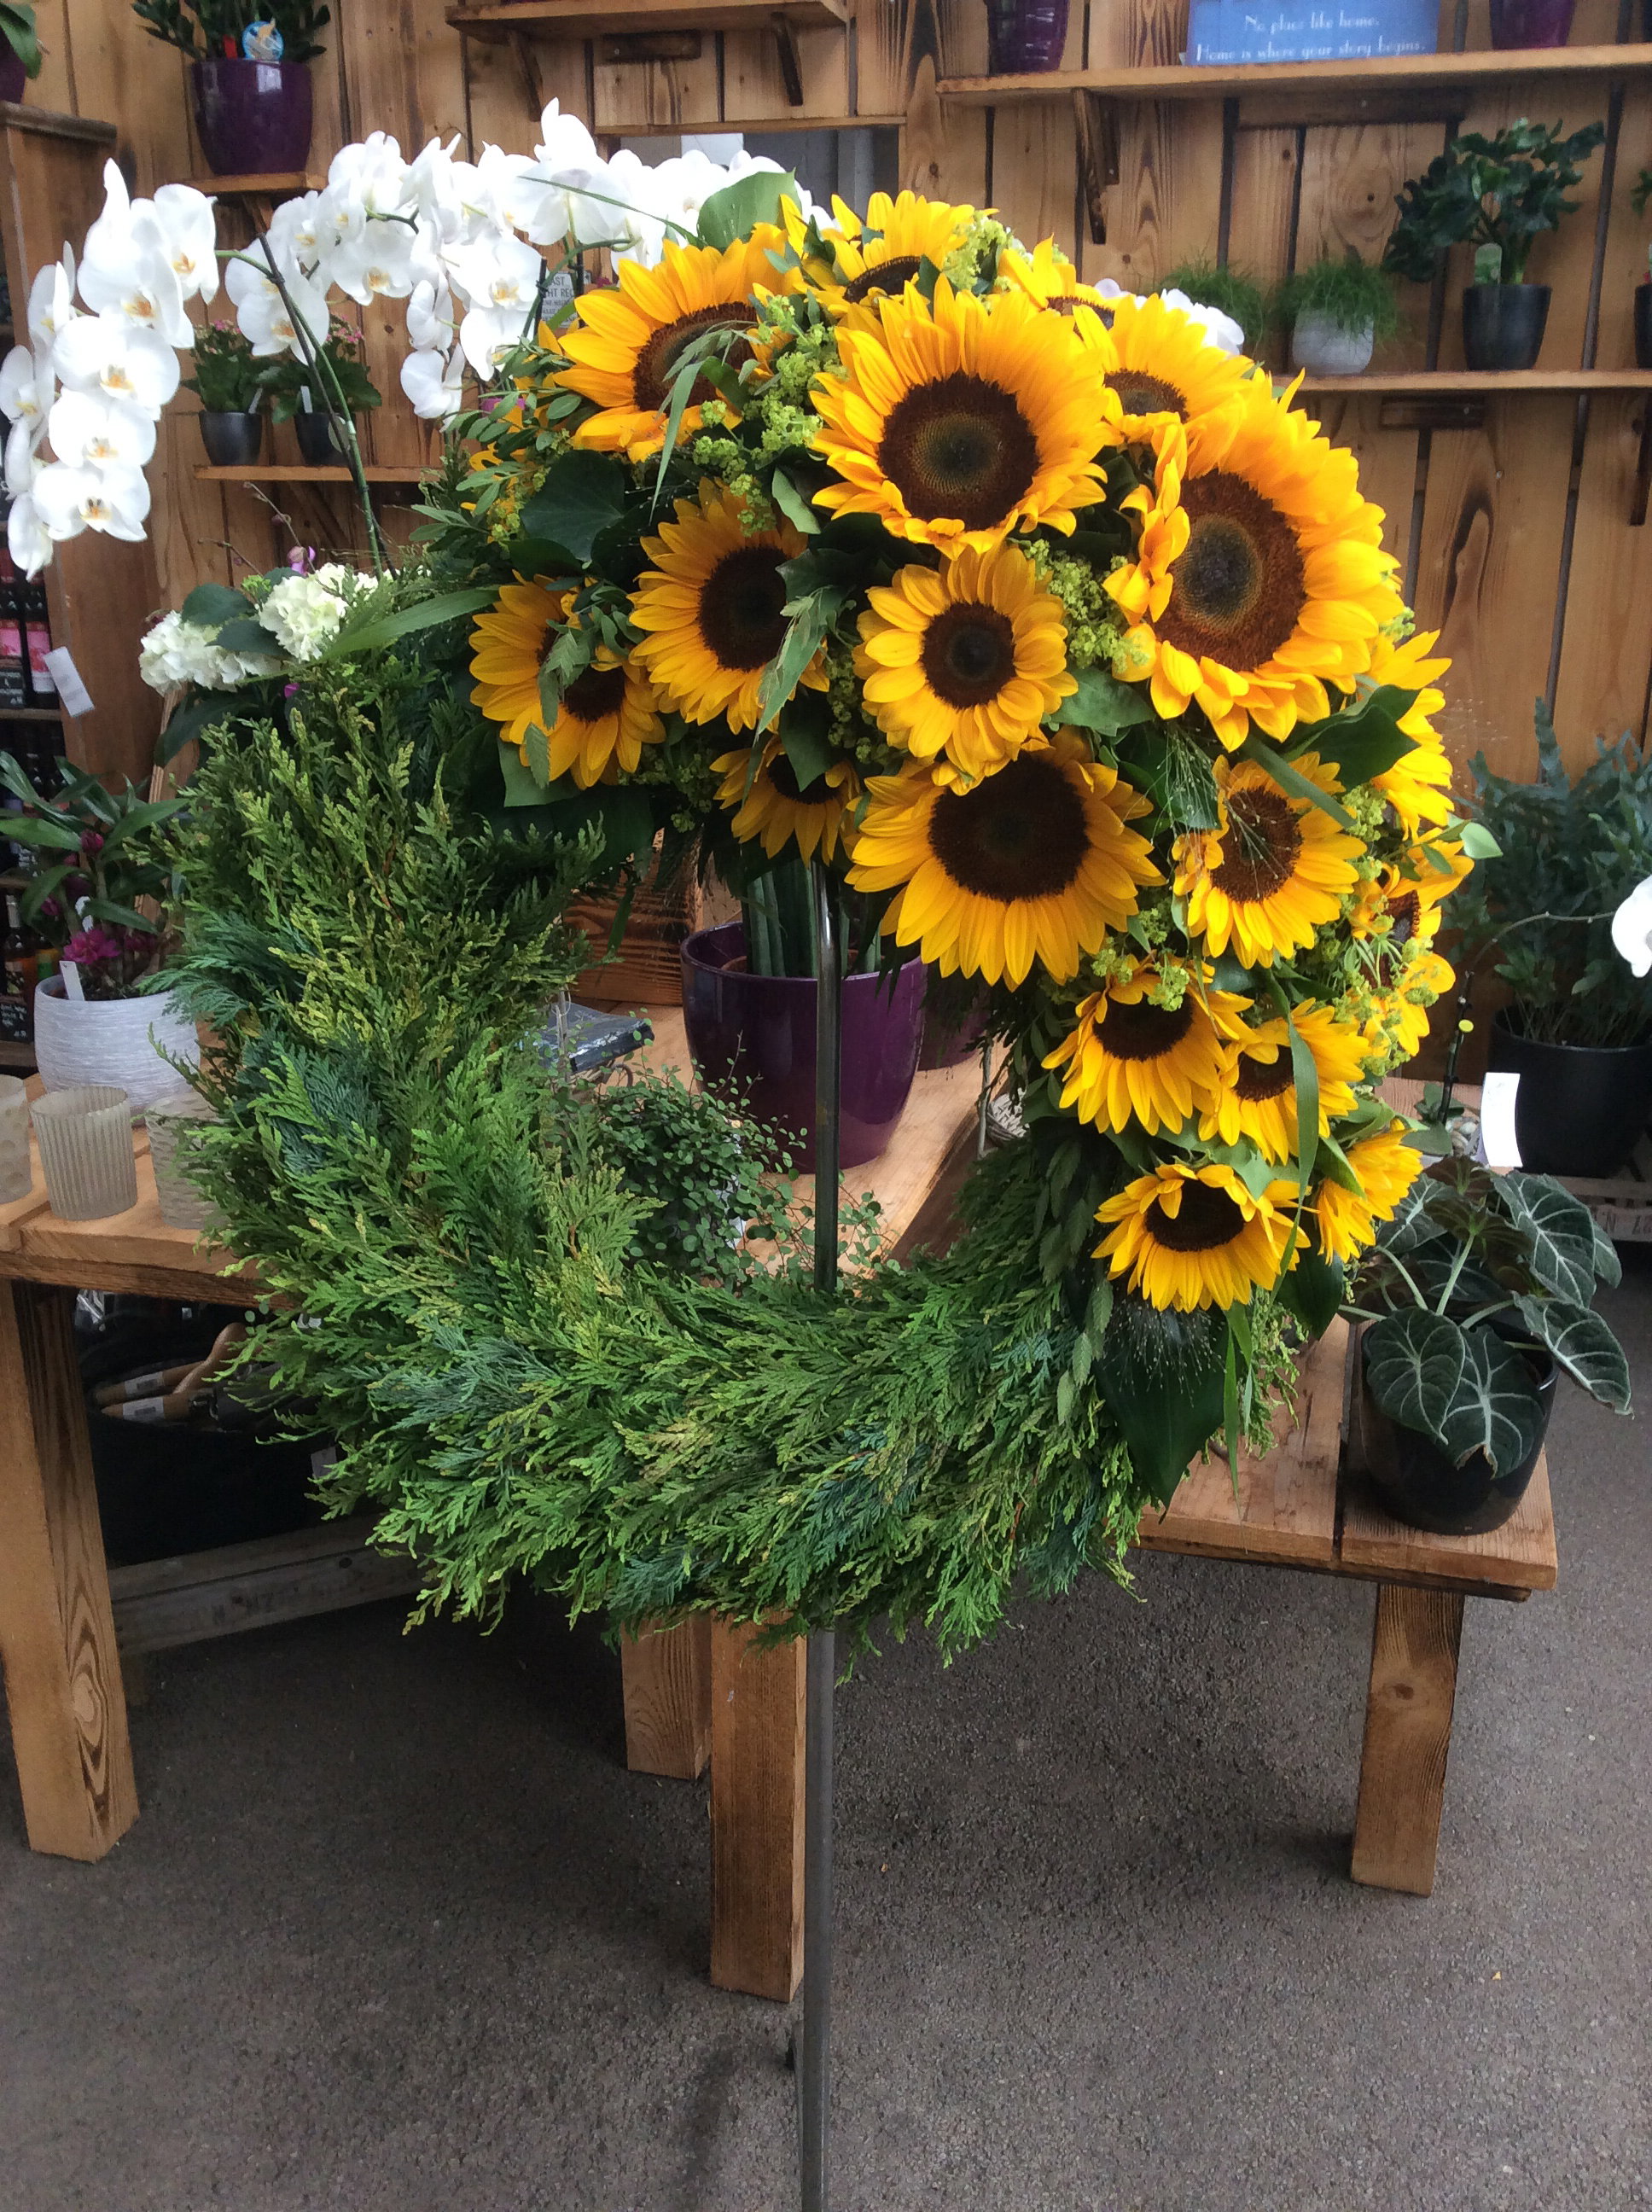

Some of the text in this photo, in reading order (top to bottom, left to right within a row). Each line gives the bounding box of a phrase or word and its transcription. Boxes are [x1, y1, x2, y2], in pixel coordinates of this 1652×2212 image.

[1244, 15, 1265, 32] No
[1310, 11, 1334, 29] like
[1196, 44, 1234, 62] Home
[1242, 50, 1252, 60] is
[1257, 41, 1295, 59] where
[1301, 47, 1332, 60] your
[1339, 39, 1371, 57] story
